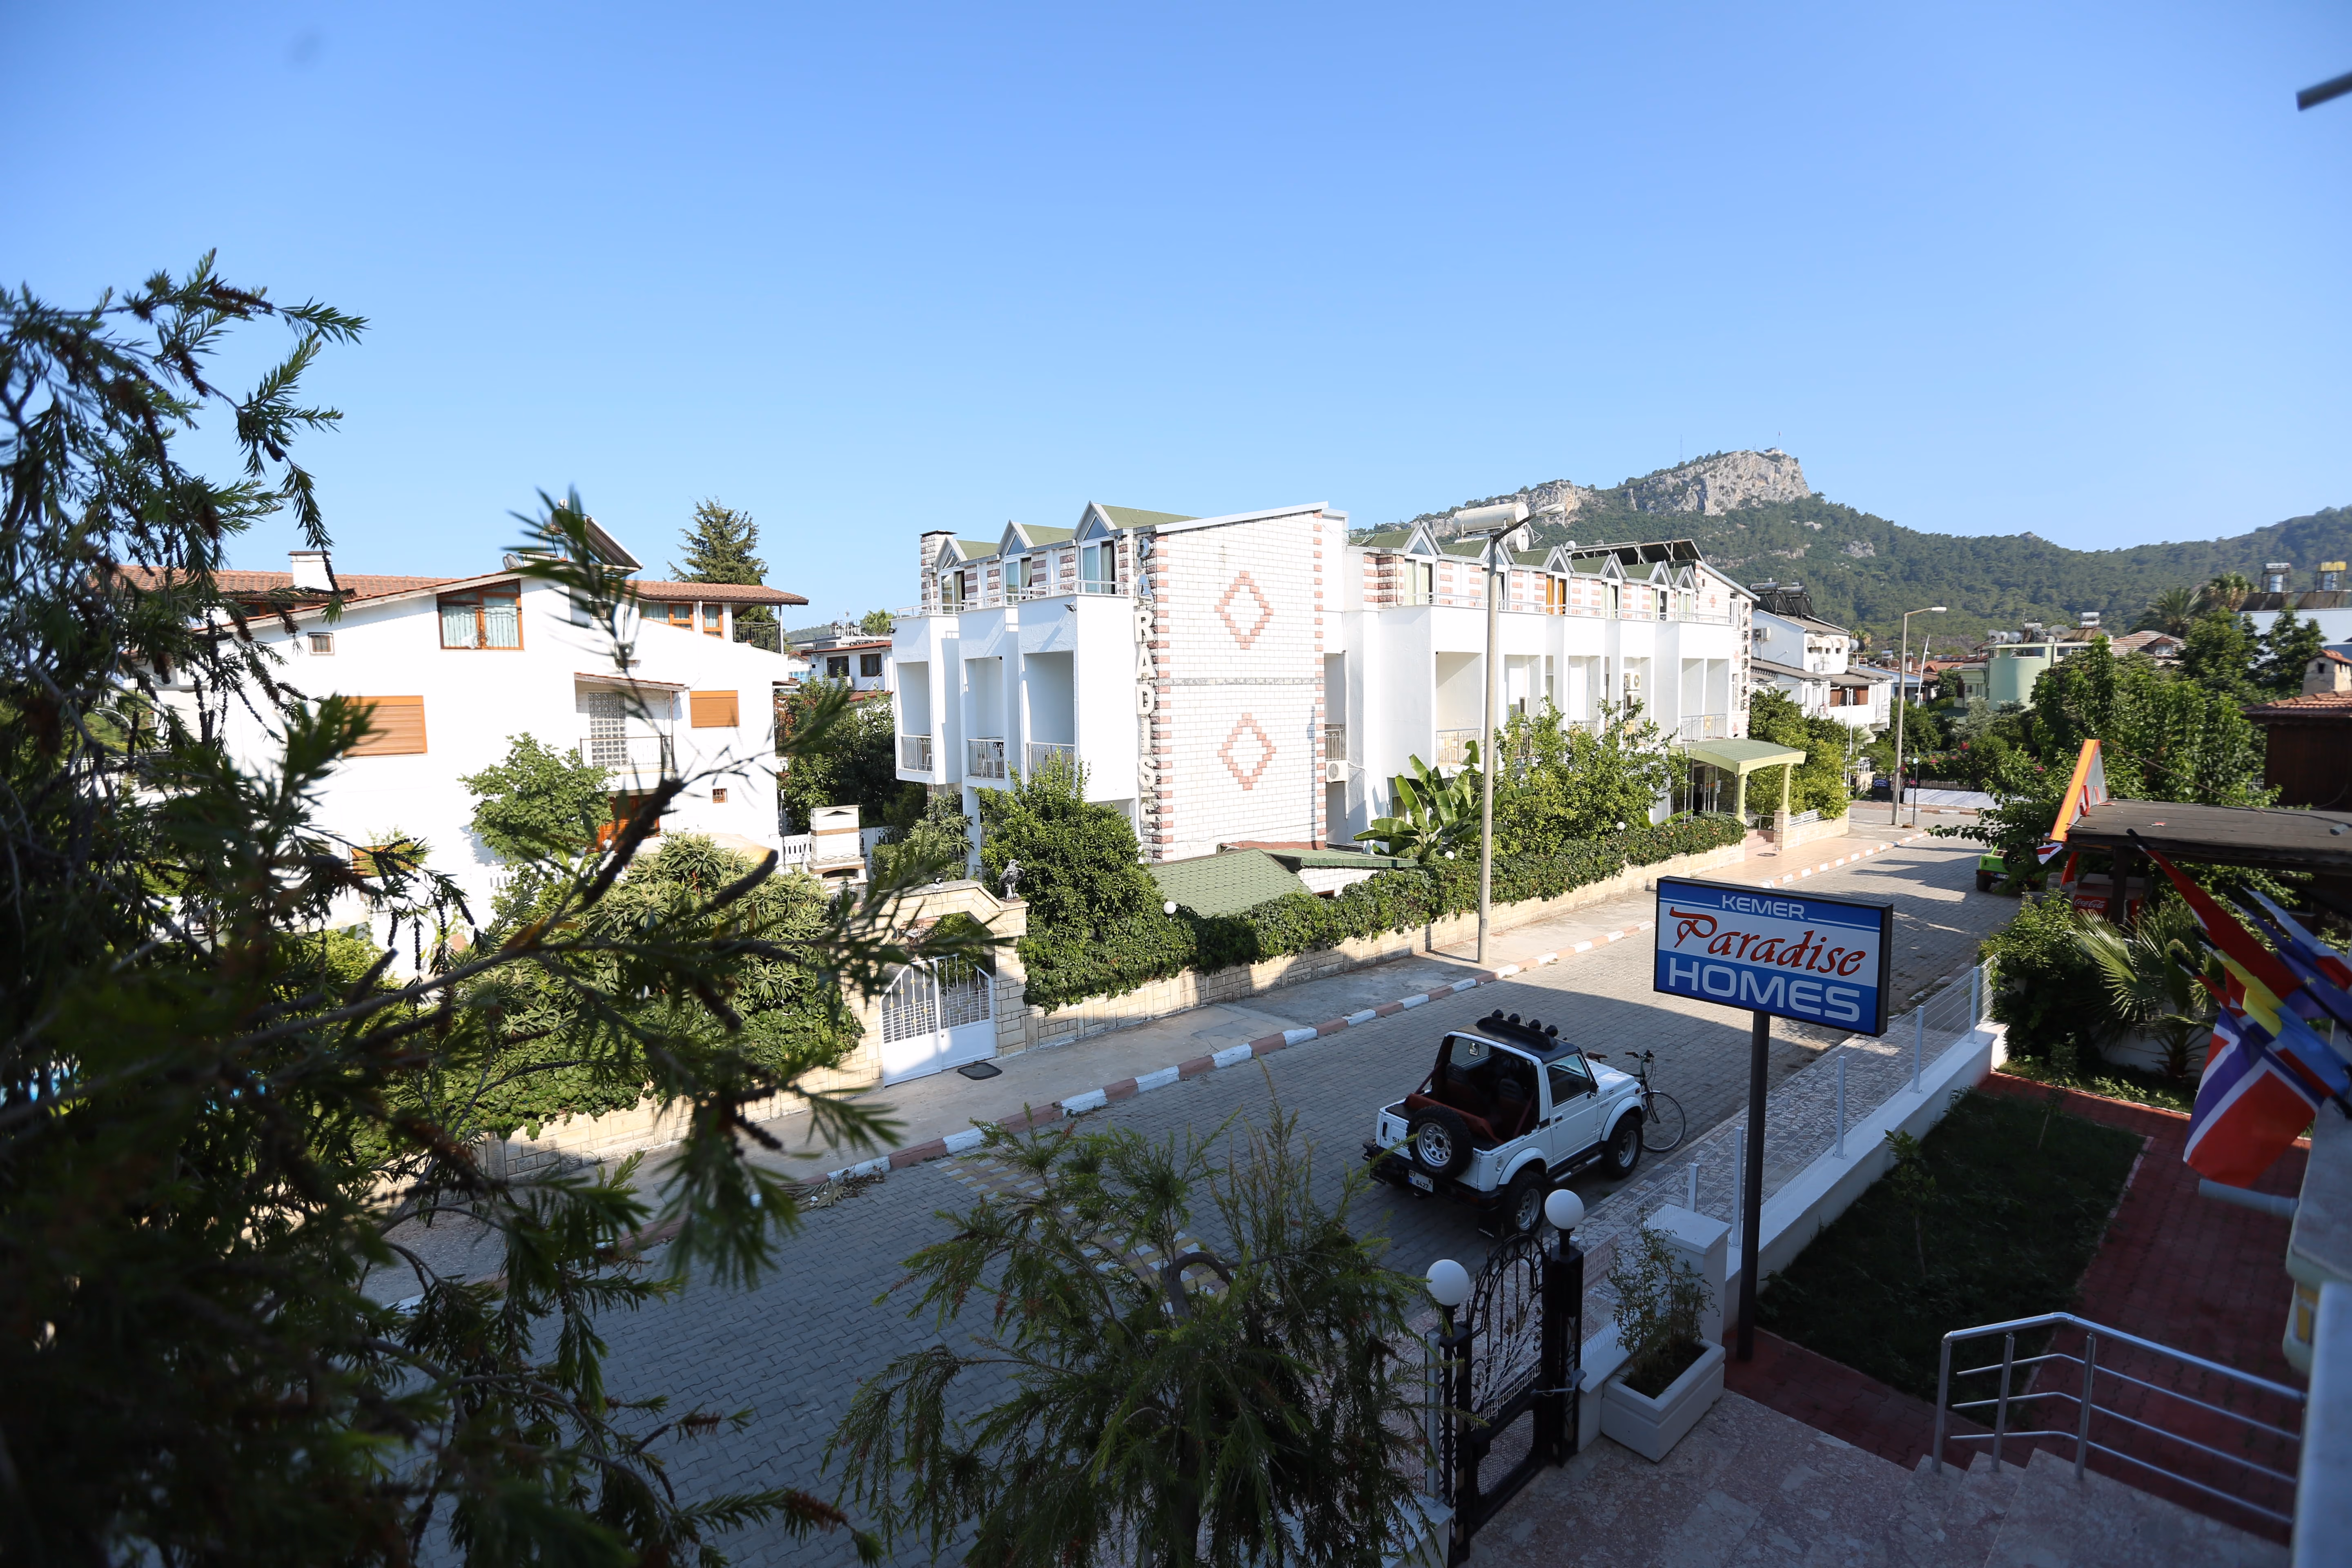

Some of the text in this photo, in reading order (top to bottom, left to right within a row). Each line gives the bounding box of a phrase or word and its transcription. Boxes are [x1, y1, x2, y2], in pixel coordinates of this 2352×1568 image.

[1134, 537, 1158, 822] PARADISE
[1741, 602, 1749, 711] PARADISE
[1669, 906, 1866, 976] Paradise
[1722, 895, 1805, 920] KEMER
[1668, 957, 1860, 1022] HOMES
[1416, 1180, 1429, 1189] 6427
